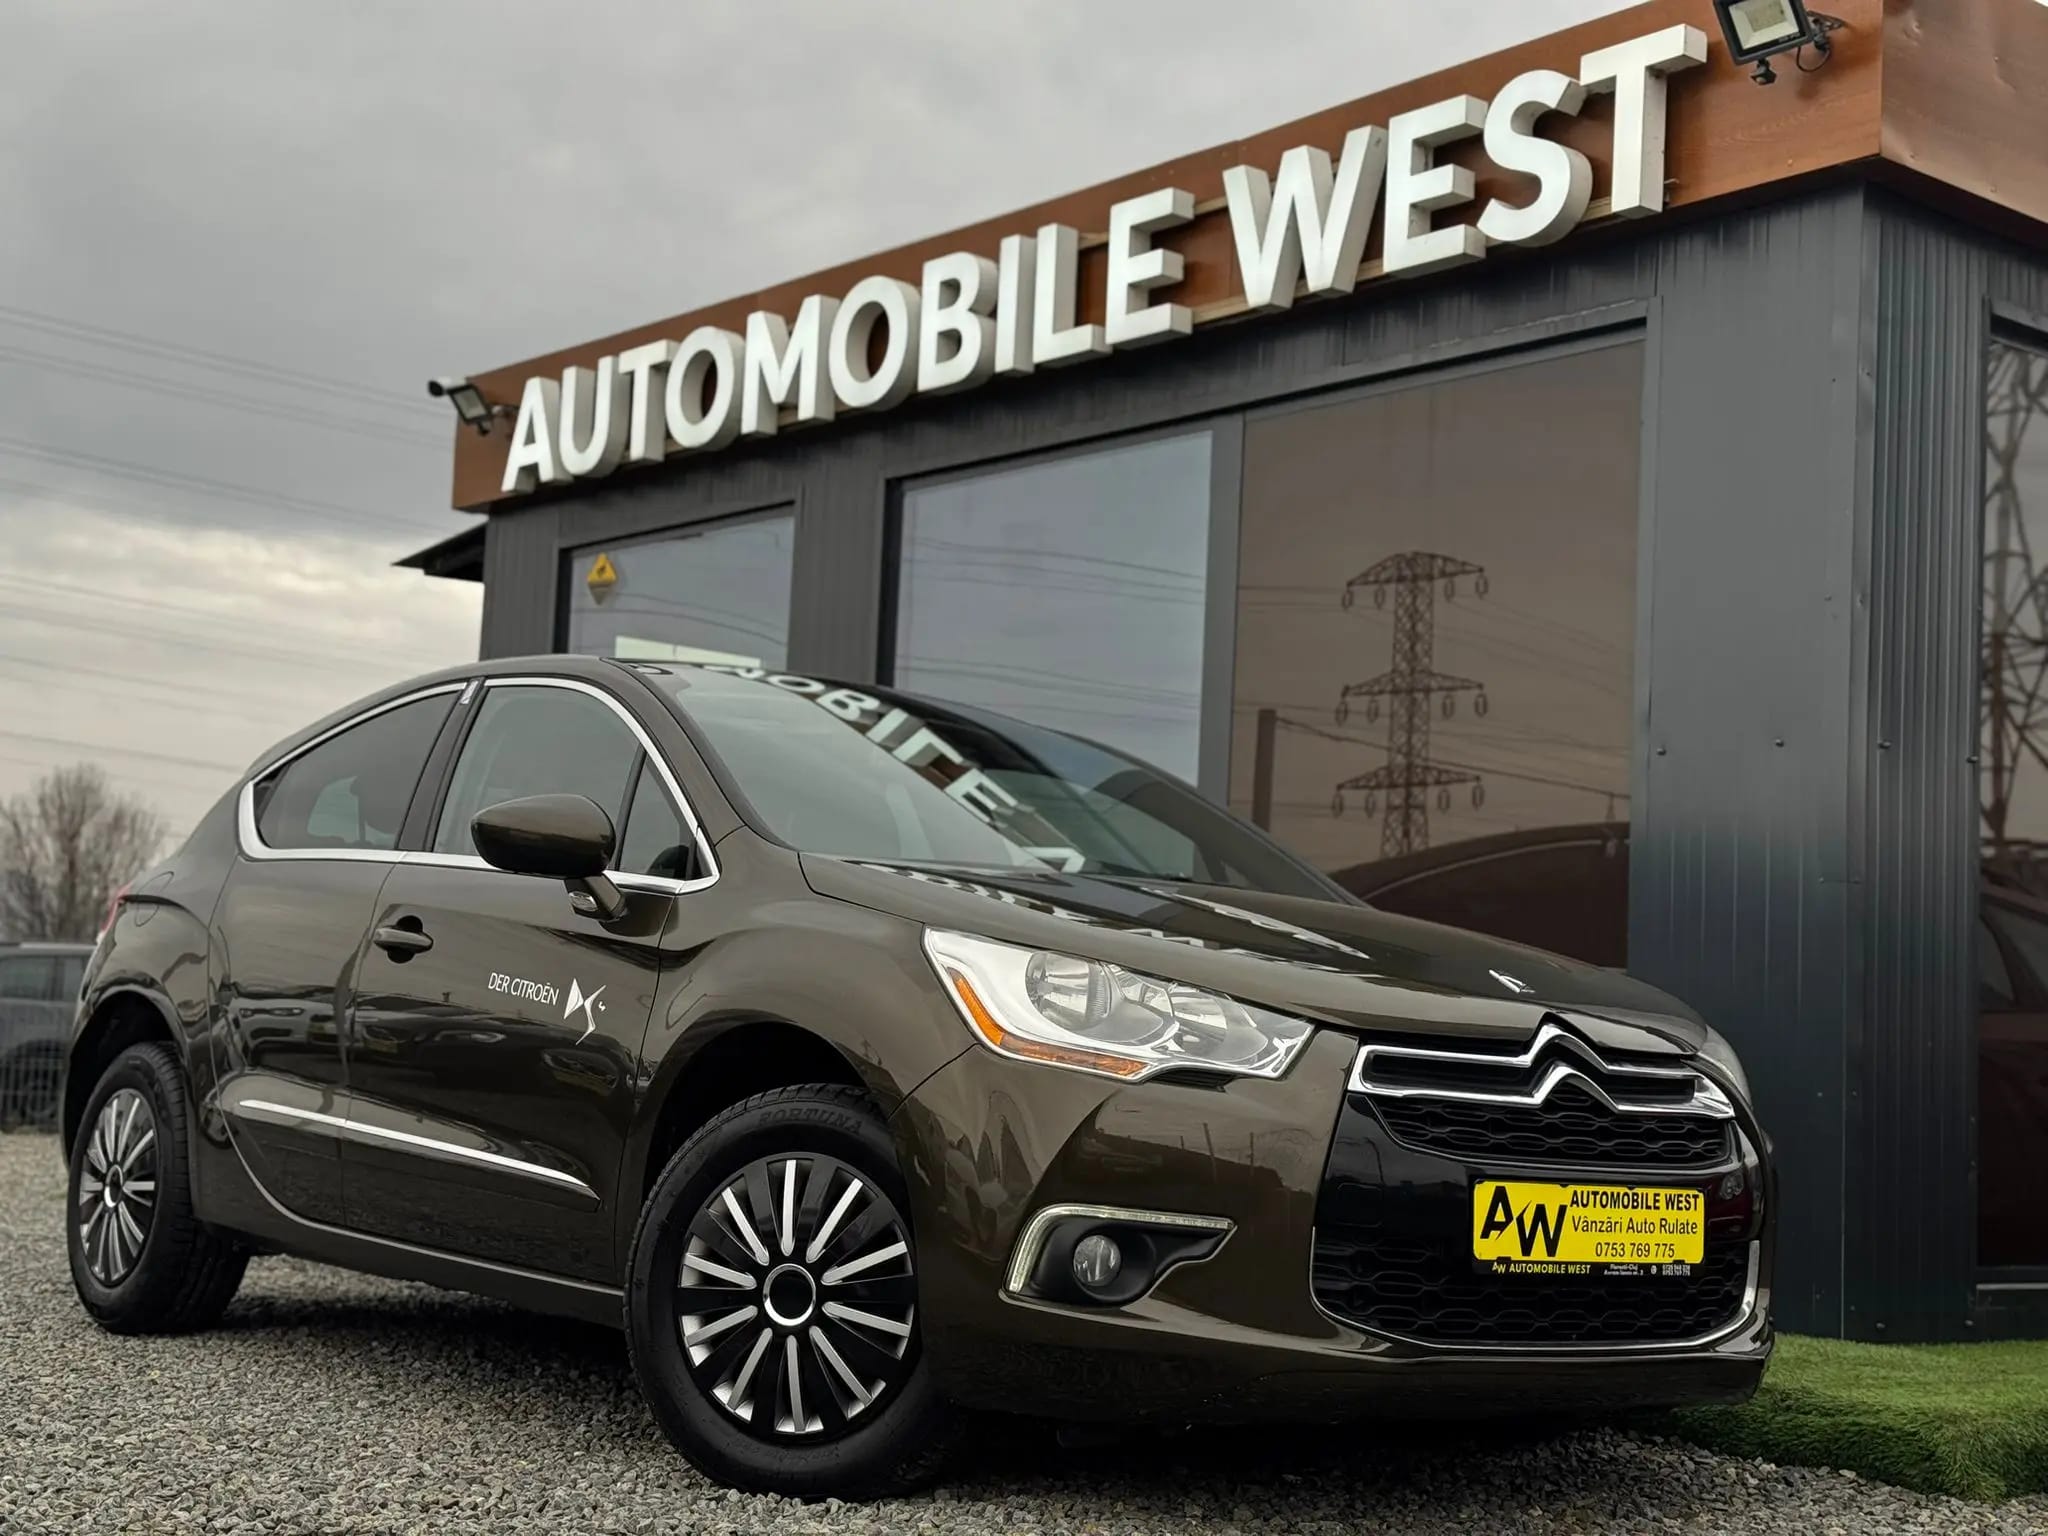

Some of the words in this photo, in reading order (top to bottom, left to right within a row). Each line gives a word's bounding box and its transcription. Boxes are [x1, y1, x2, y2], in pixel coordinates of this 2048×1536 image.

[501, 186, 1195, 495] AUTOMOBILE
[1222, 24, 1708, 313] WEST
[487, 972, 509, 993] DER
[511, 978, 559, 1006] CITROËN
[759, 1108, 863, 1135] FORTUNA
[1570, 1190, 1661, 1210] AUTOMOBILE
[1665, 1193, 1700, 1211] WEST
[1626, 1217, 1656, 1234] Auto
[1659, 1217, 1698, 1235] Rulate
[1595, 1242, 1626, 1258] 0753
[1630, 1243, 1651, 1258] 769
[1654, 1243, 1675, 1258] 775
[1509, 1263, 1566, 1273] AUTOMOBILE
[1567, 1264, 1591, 1274] WEST
